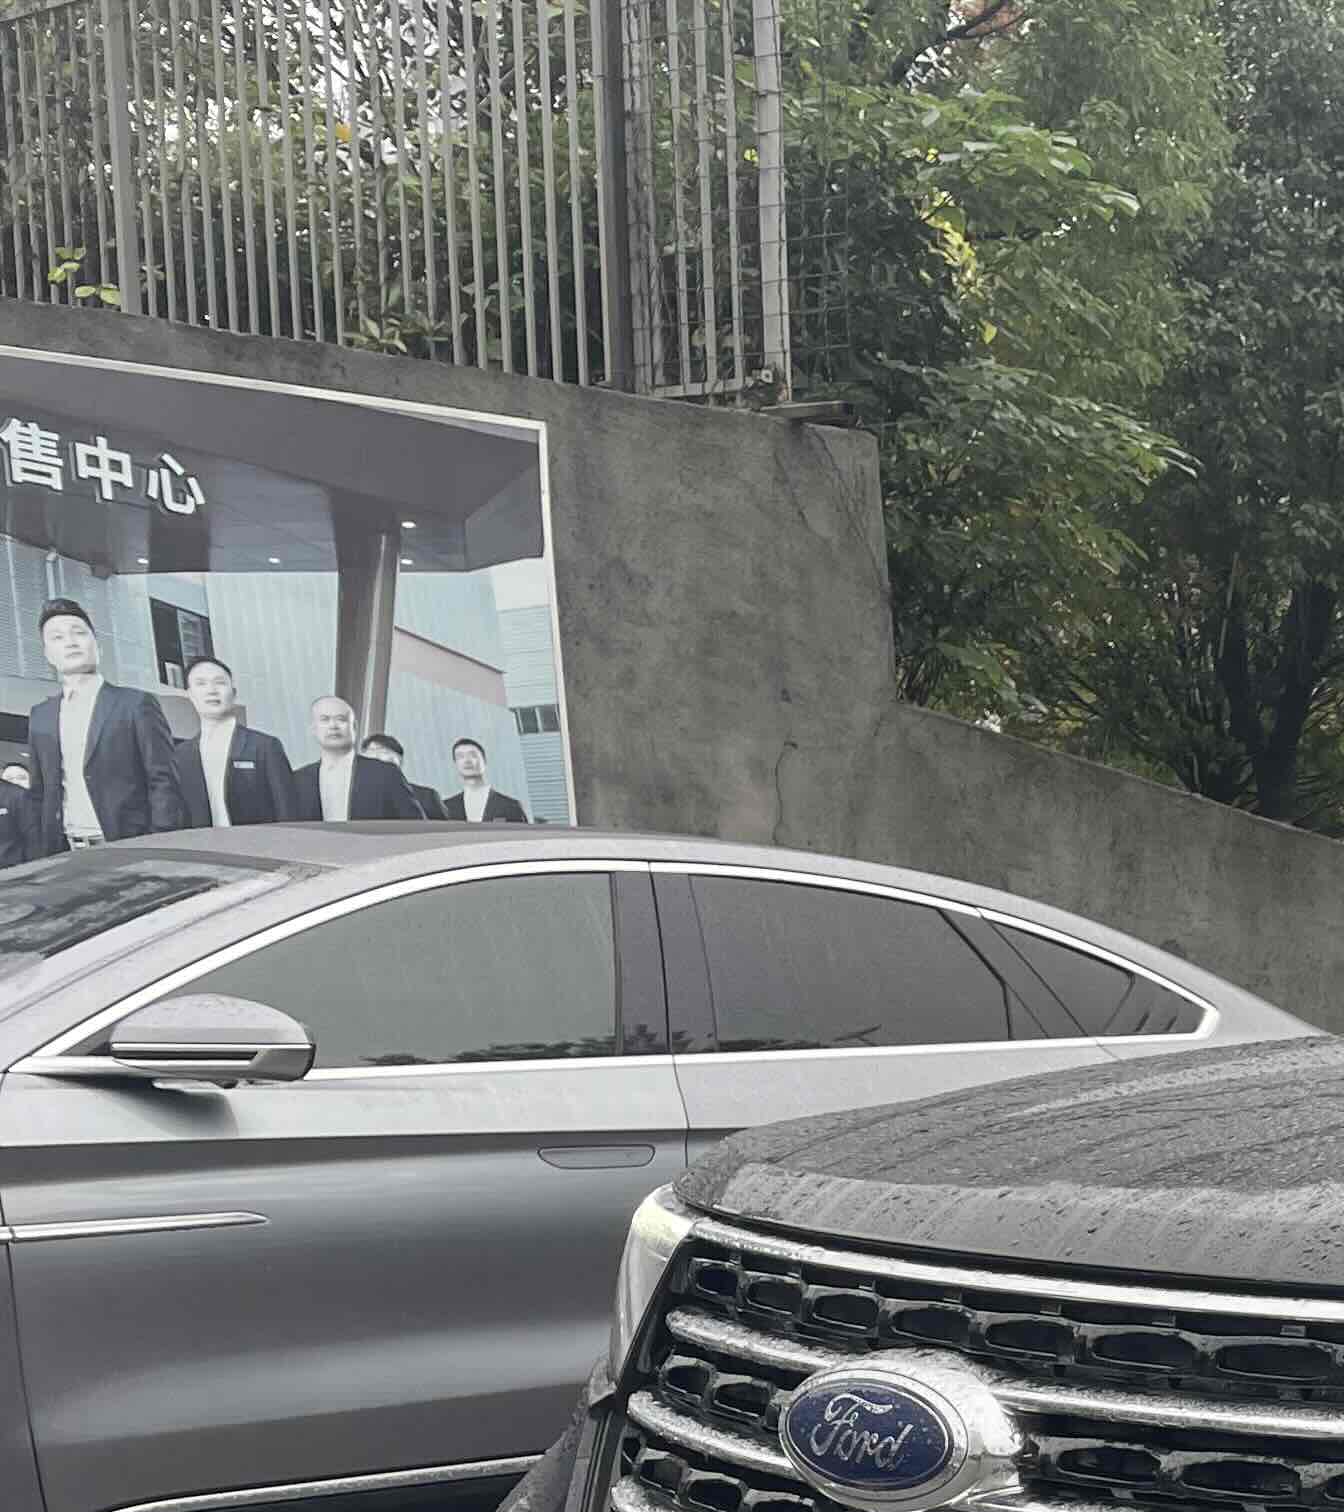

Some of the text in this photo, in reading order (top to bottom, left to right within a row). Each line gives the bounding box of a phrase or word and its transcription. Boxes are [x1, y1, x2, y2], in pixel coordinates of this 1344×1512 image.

[0, 417, 206, 515] 售中心
[810, 1393, 914, 1472] Ford
